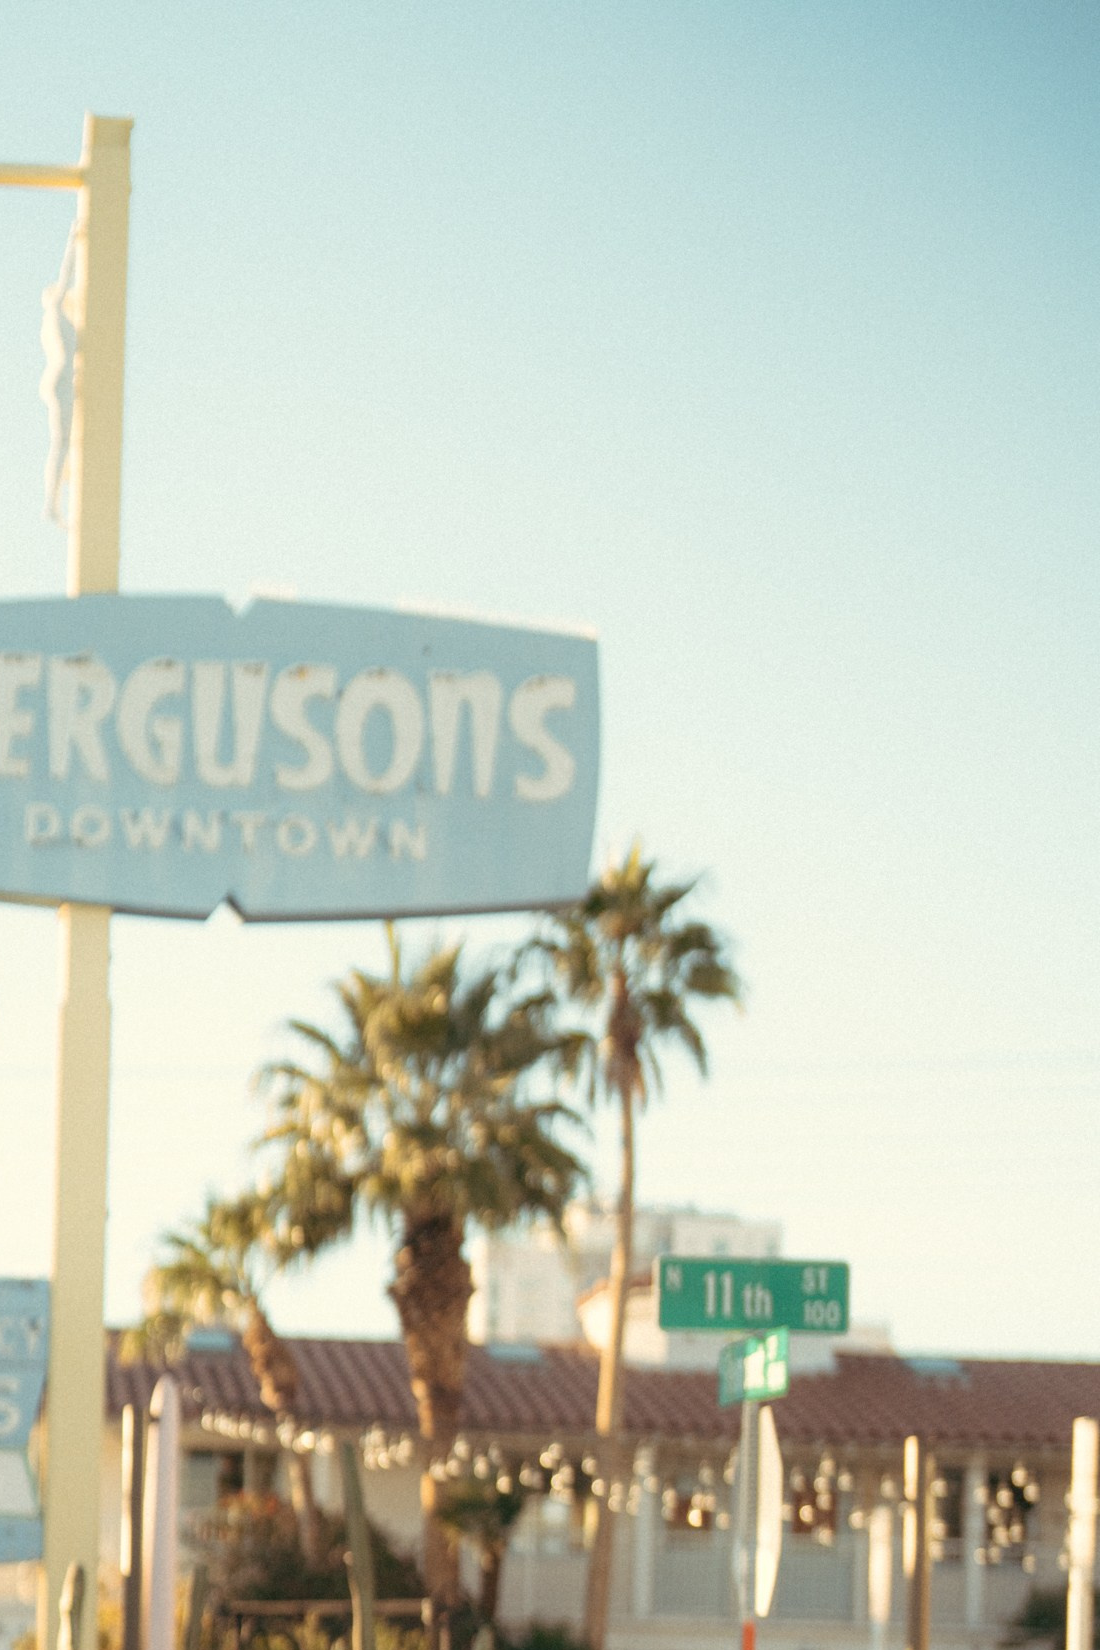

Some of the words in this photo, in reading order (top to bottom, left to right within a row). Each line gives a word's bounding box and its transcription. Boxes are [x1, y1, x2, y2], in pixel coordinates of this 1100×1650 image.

[23, 802, 428, 863] DOWNTOWN
[665, 1264, 683, 1292] N
[704, 1270, 773, 1320] 11th
[803, 1299, 842, 1328] 100
